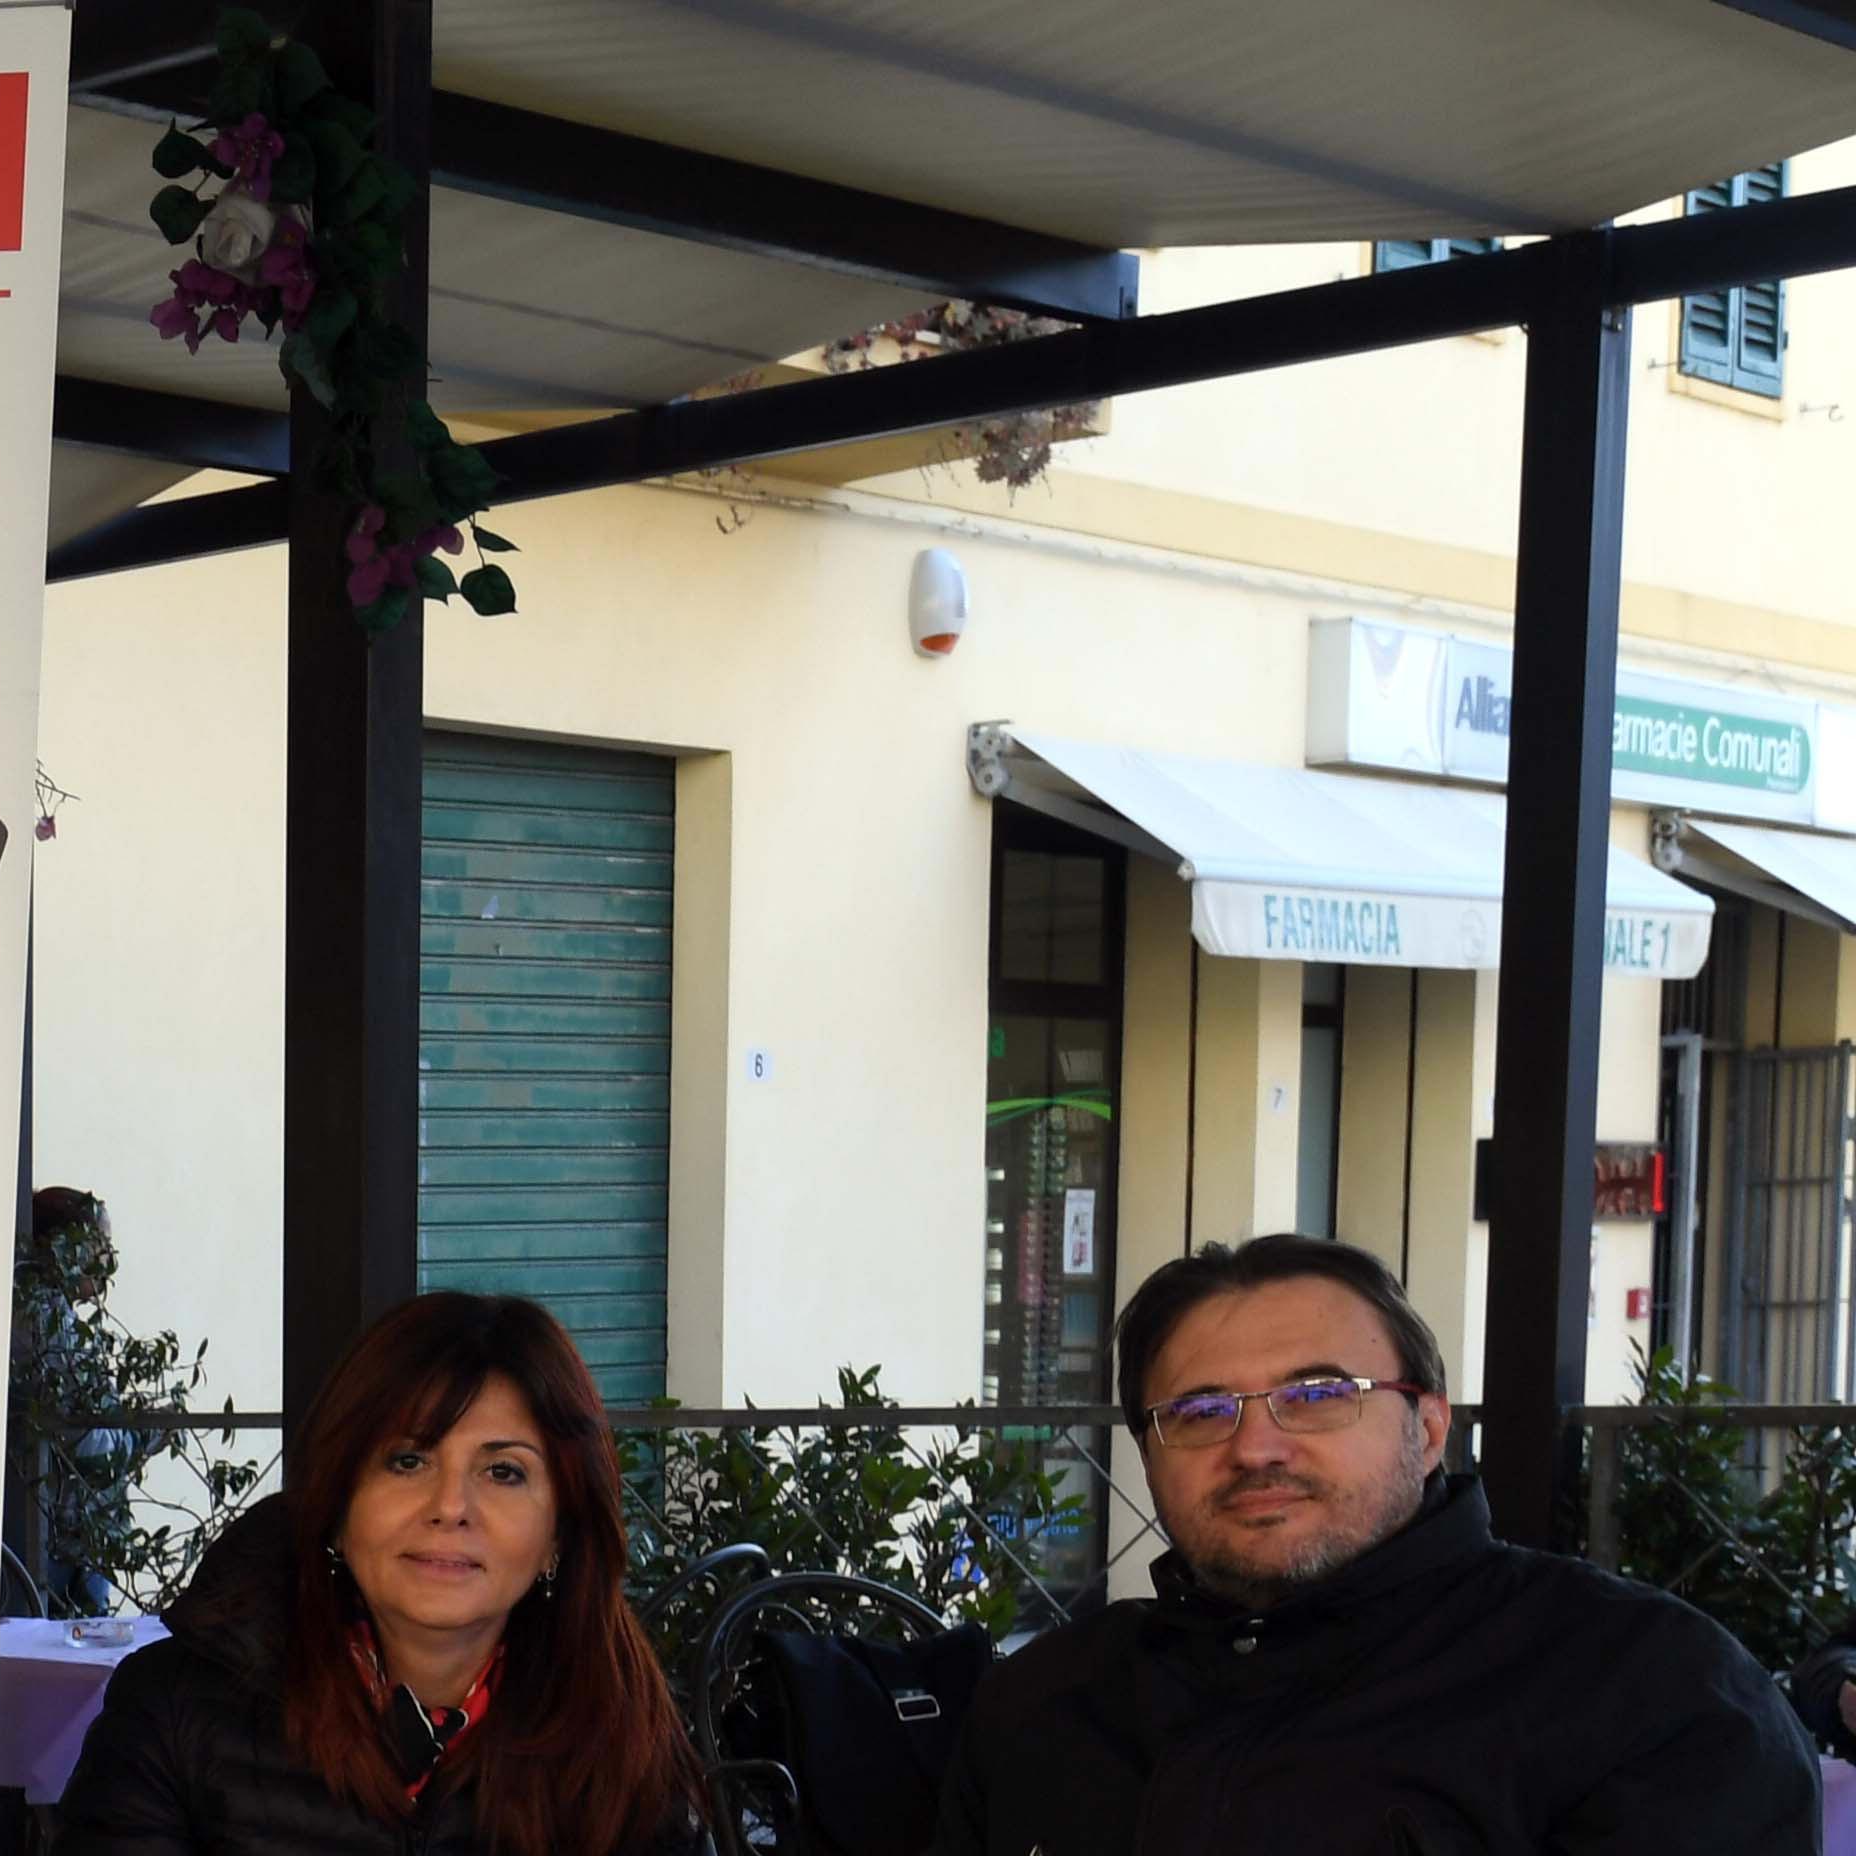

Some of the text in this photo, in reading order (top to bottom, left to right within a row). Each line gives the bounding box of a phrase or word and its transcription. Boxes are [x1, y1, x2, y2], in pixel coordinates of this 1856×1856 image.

[1455, 675, 1512, 737] Allia
[1613, 711, 1801, 777] armacie Comunali
[1263, 894, 1400, 956] FARMACIA
[1660, 921, 1671, 969] 1
[754, 1053, 763, 1078] 6
